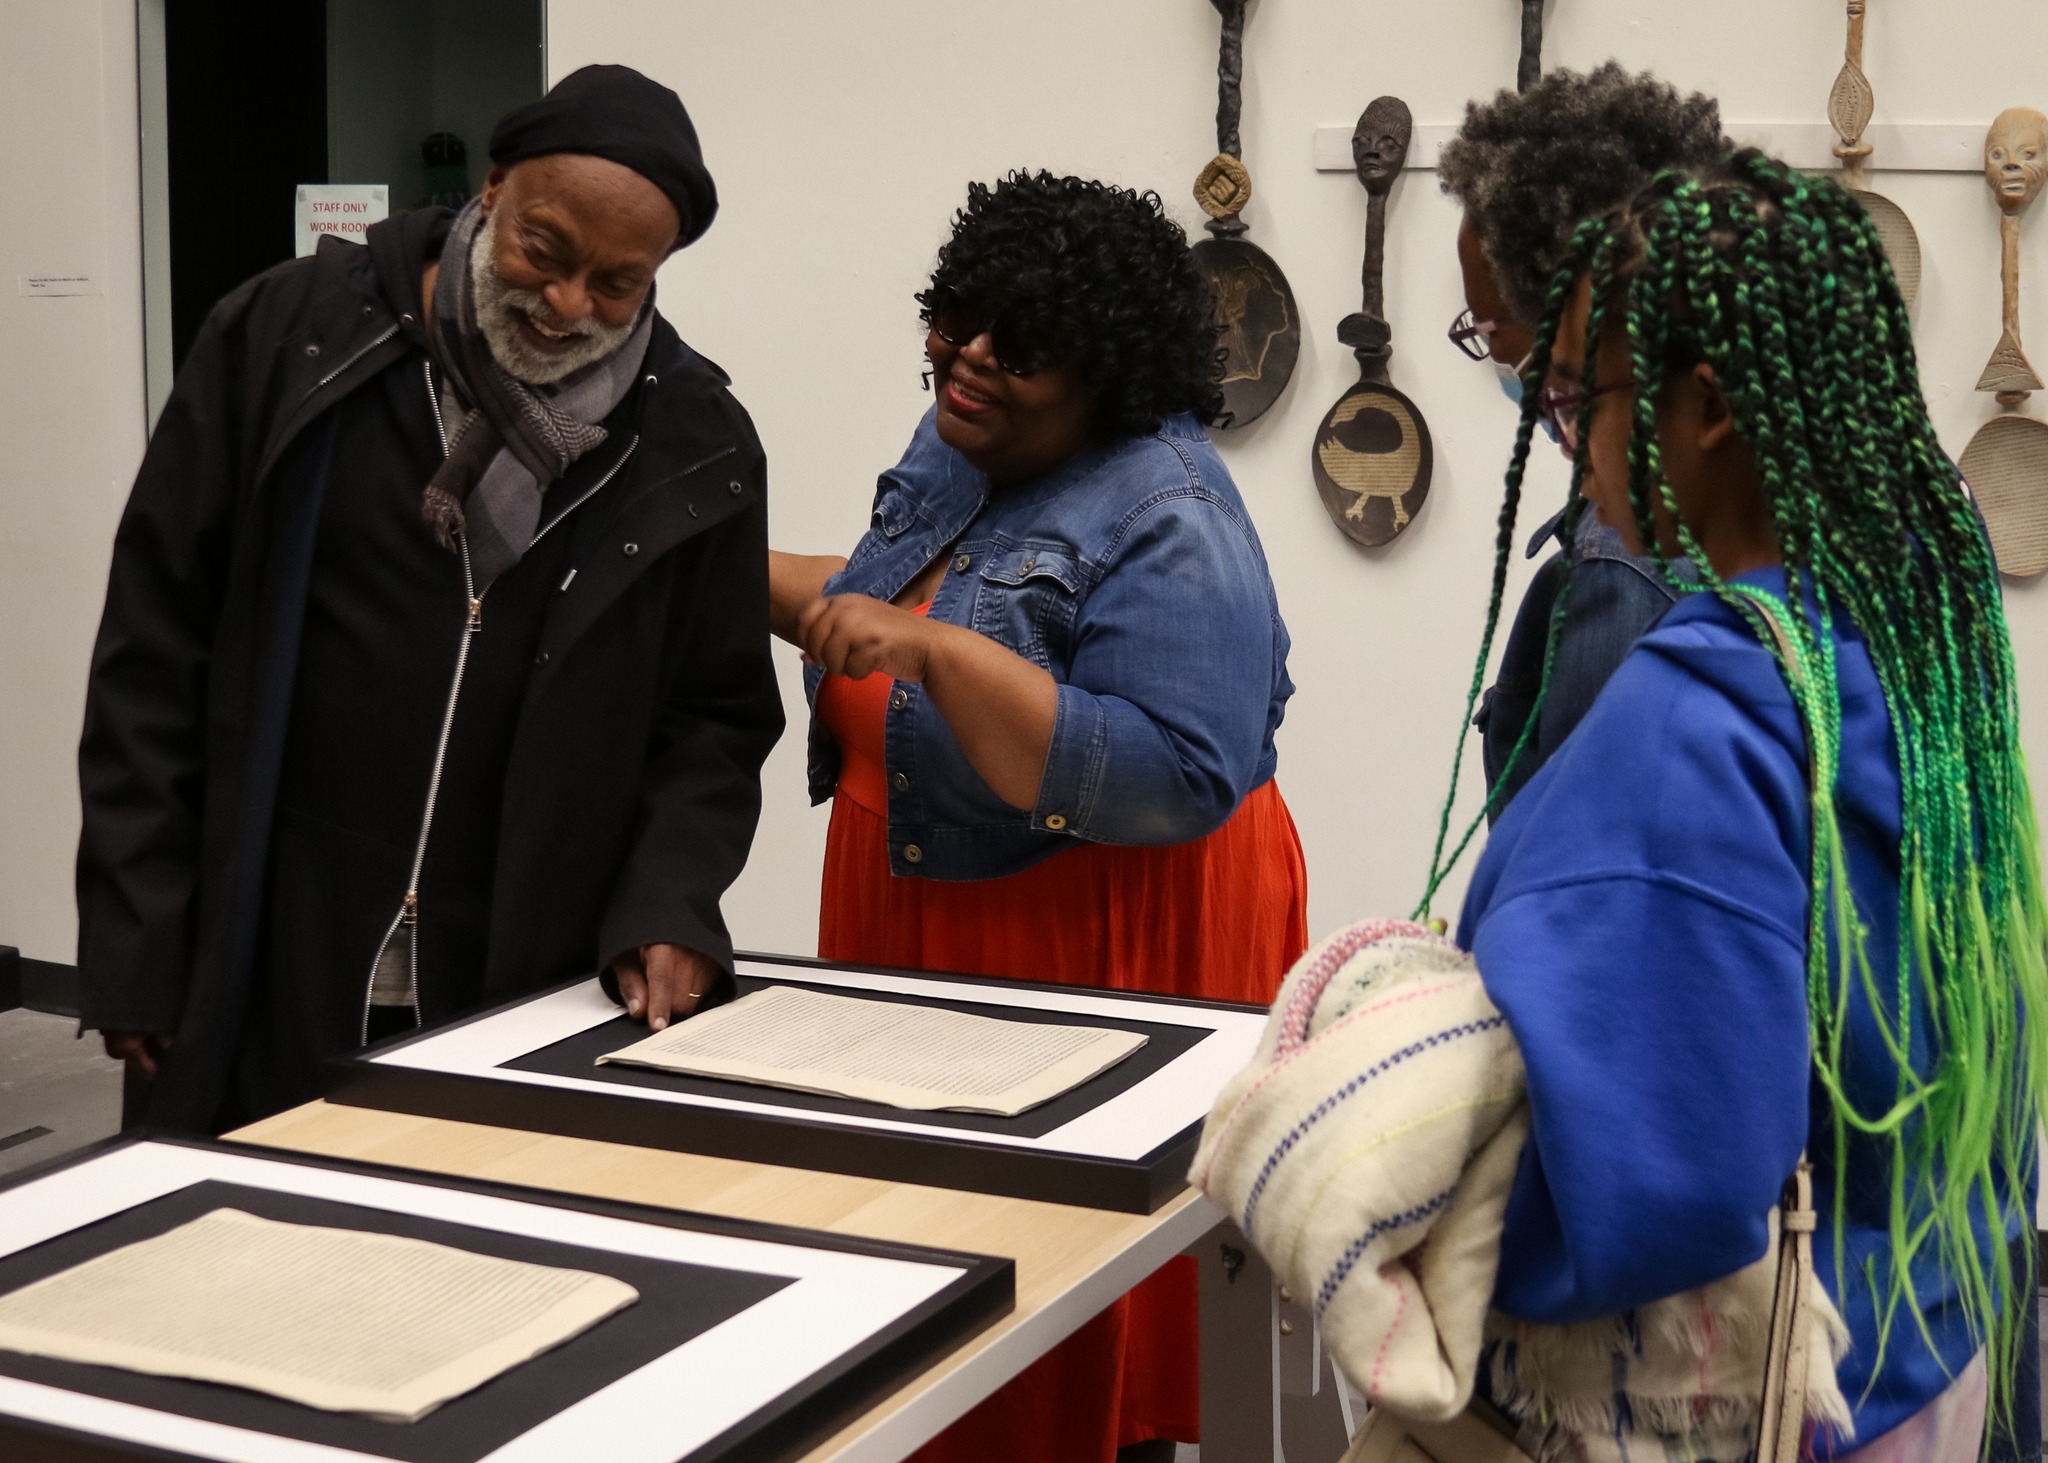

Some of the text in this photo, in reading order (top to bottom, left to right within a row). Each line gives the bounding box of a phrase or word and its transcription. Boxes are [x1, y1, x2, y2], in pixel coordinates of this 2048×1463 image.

[313, 203, 368, 213] STAFF ONLY
[310, 222, 339, 232] WORK
